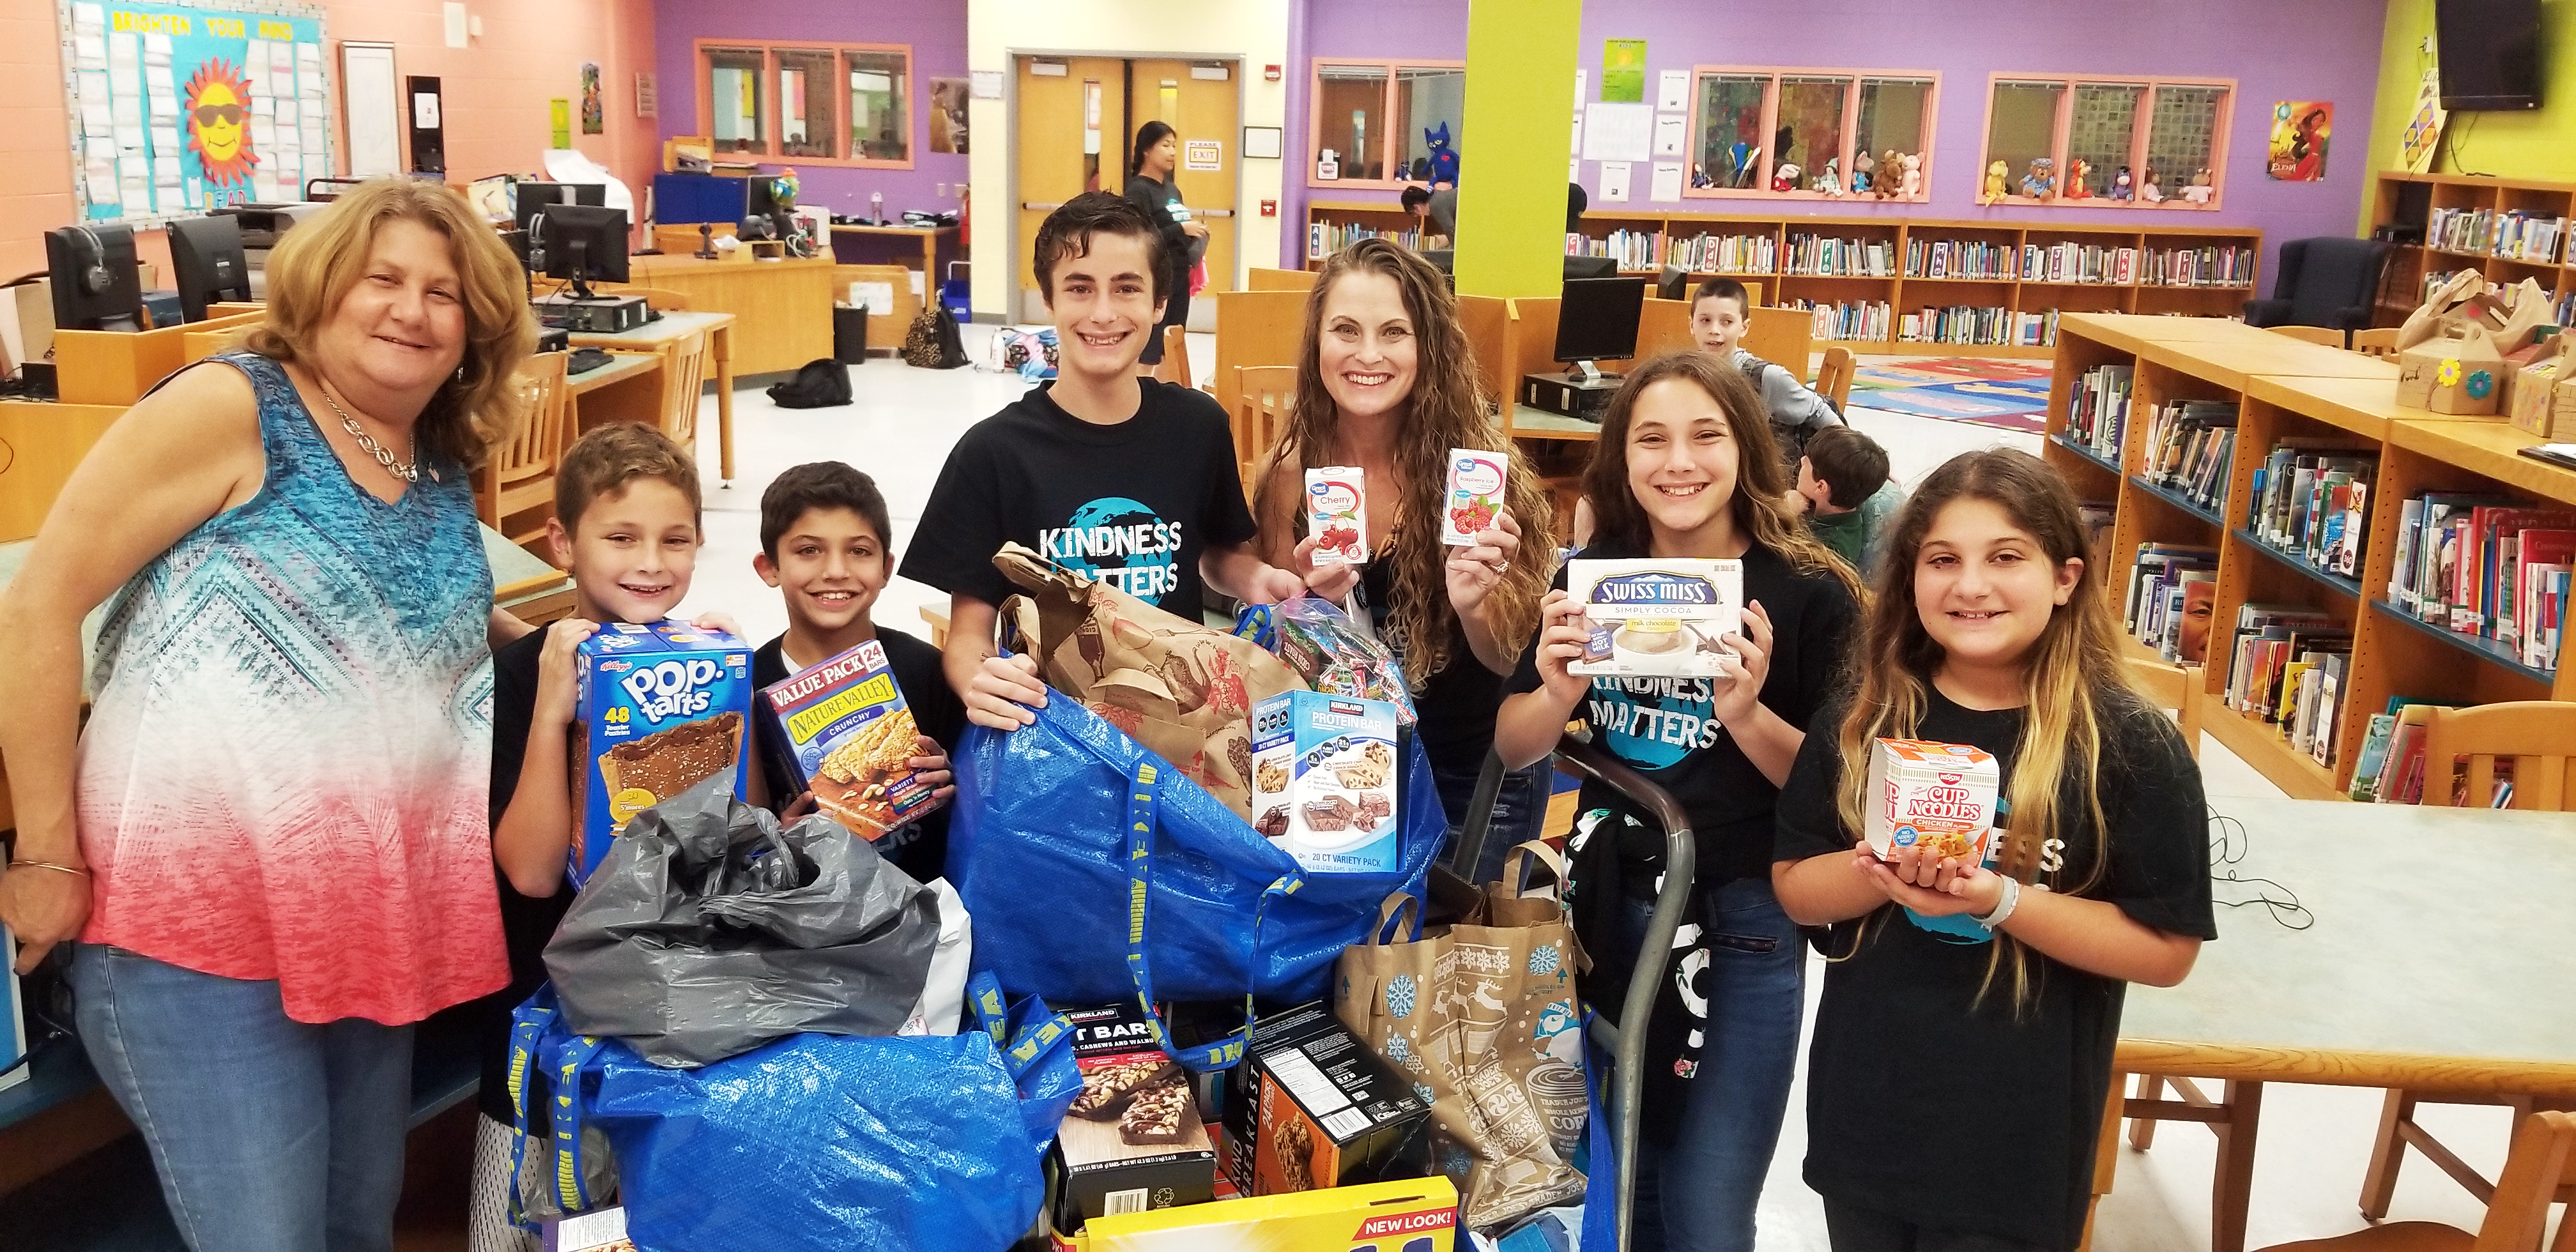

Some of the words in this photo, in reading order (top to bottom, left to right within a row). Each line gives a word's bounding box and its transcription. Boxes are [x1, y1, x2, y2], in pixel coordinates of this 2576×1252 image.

[113, 11, 191, 36] BRIGHTEN
[206, 18, 246, 38] YOUR
[259, 19, 293, 41] MIND
[1193, 151, 1215, 159] EXIT
[1320, 496, 1351, 505] Cherry
[1039, 521, 1182, 558] KINDNESS
[1045, 563, 1179, 597] TTERS
[1600, 582, 1655, 603] SWISS
[1660, 582, 1707, 604] MISS
[1591, 637, 1607, 647] HOT
[1592, 643, 1610, 652] MILK
[863, 644, 882, 662] 24
[869, 658, 885, 669] BARS
[771, 674, 825, 707] VALUE
[822, 654, 865, 685] PACK
[1592, 676, 1715, 703] INDNES
[604, 706, 631, 724] 48
[641, 691, 712, 723] tarts
[792, 698, 845, 739] NATURE
[842, 676, 890, 706] VALLEY
[1256, 700, 1280, 716] PROTEIN
[1280, 698, 1291, 708] BAR
[1330, 701, 1363, 712] KIRKLAND
[829, 711, 870, 736] CRUNCHY
[1312, 712, 1359, 728] PROTEIN
[1360, 719, 1381, 730] BAR
[1589, 699, 1722, 749] MATTERS
[1280, 735, 1289, 744] PACK
[891, 777, 914, 792] VARIETY
[1940, 774, 1961, 782] NISSIN
[1927, 786, 1970, 804] CUP
[1907, 799, 1981, 821] NOODLES
[1916, 819, 1954, 828] CHICKEN
[1312, 853, 1321, 861] 20
[1322, 854, 1331, 862] CT
[1332, 854, 1361, 866] VARIETY
[1363, 859, 1381, 867] PACK
[1070, 1009, 1115, 1019] KIRKLAND
[1080, 1041, 1113, 1050] CASHEWS
[1470, 1062, 1500, 1086] TRADER
[1540, 1097, 1569, 1106] TRADER
[1261, 1110, 1273, 1132] 24
[1543, 1108, 1569, 1116] WHOLE
[1242, 1064, 1261, 1198] BREAKFAST
[1549, 1113, 1588, 1131] COR
[1230, 1139, 1243, 1187] KIND
[1365, 1218, 1402, 1235] NEW
[1405, 1212, 1452, 1229] LOOK!
